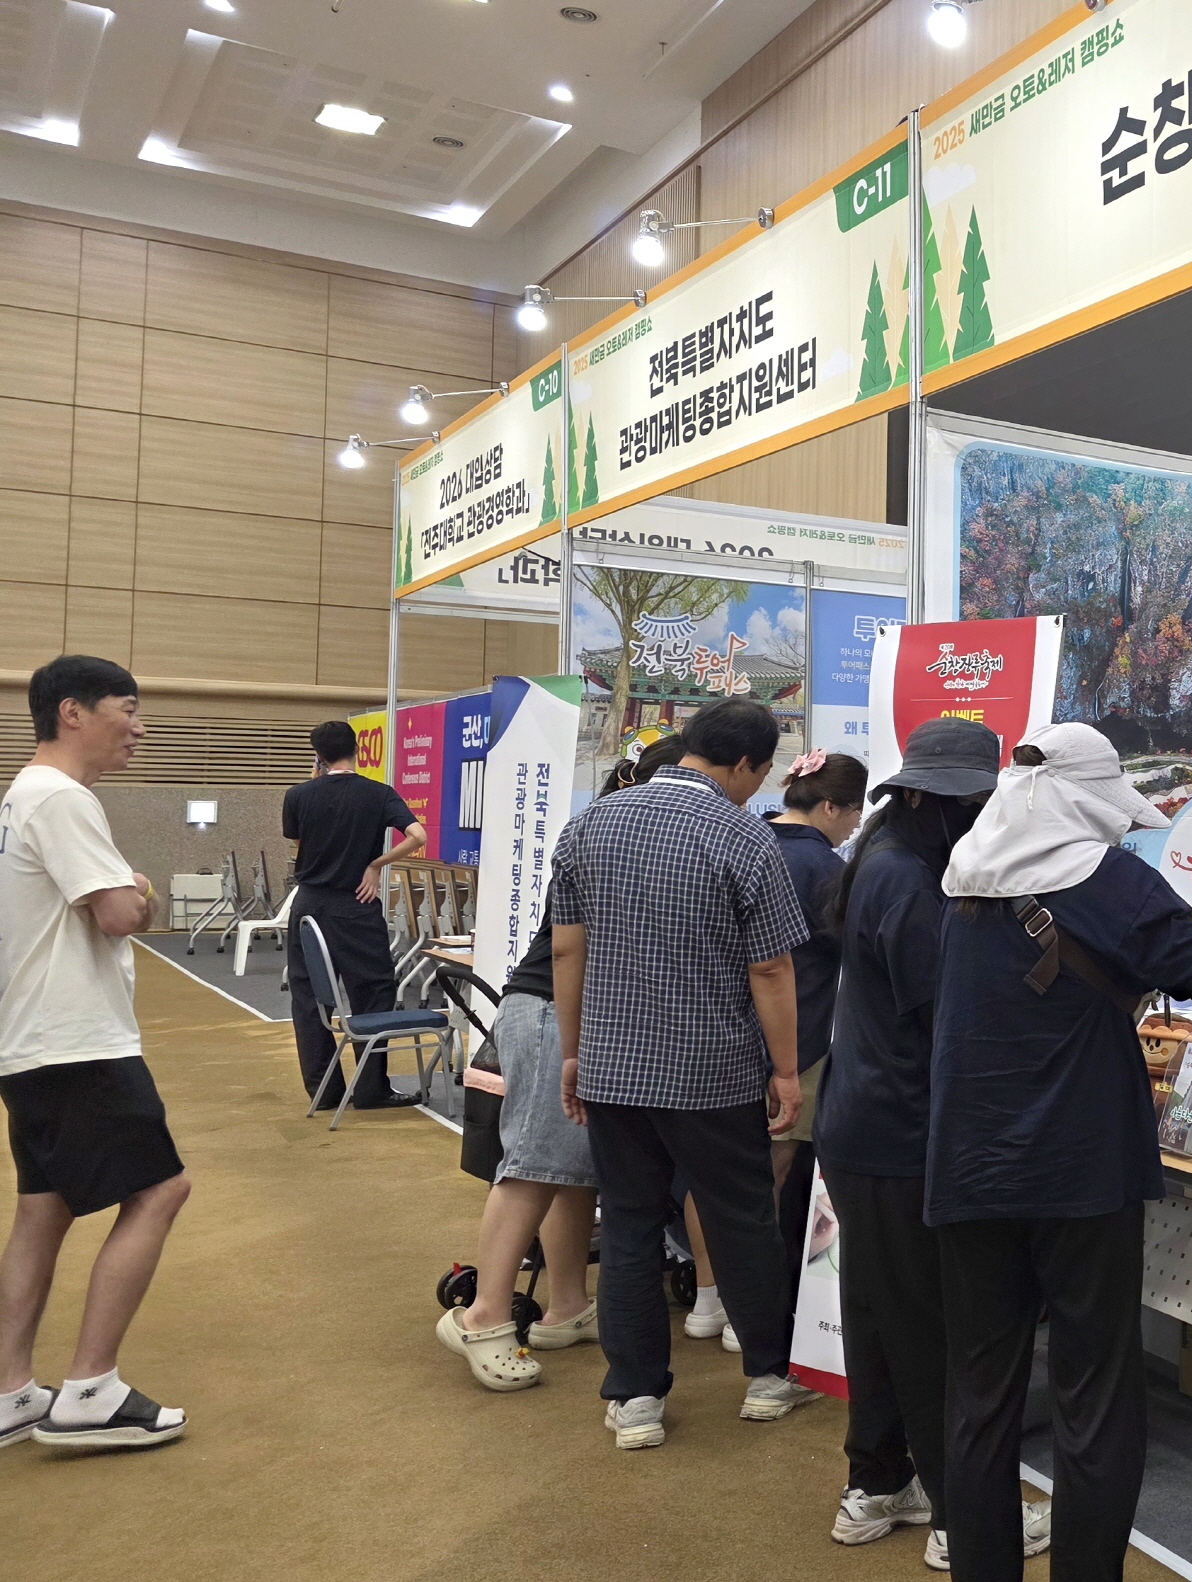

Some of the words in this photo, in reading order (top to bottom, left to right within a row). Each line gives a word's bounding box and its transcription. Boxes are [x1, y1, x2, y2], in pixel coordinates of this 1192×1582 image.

[933, 120, 965, 160] 2025
[969, 93, 1005, 138] 새만금
[1010, 47, 1075, 112] 오토&레저
[1080, 17, 1125, 68] 캠핑쇼
[853, 161, 892, 215] C-11
[573, 354, 588, 375] 2025
[589, 346, 605, 367] 새만금
[606, 325, 634, 357] 오토&레저
[634, 316, 653, 341] 캠핑쇼
[649, 290, 774, 398] 전북특별자치도
[538, 371, 559, 403] C-10
[619, 337, 817, 471] 관광마케팅종합지원센터
[440, 468, 463, 510] 2026
[465, 443, 503, 494] 대입상담
[421, 511, 464, 560] 「전주대학교
[466, 478, 530, 540] 관광경영학과」
[832, 673, 853, 683] 다양한
[855, 674, 869, 684] 가맹
[840, 648, 862, 657] 하나의
[864, 649, 873, 658] 모
[926, 650, 1002, 679] 순창장류축제
[844, 721, 857, 735] 왜
